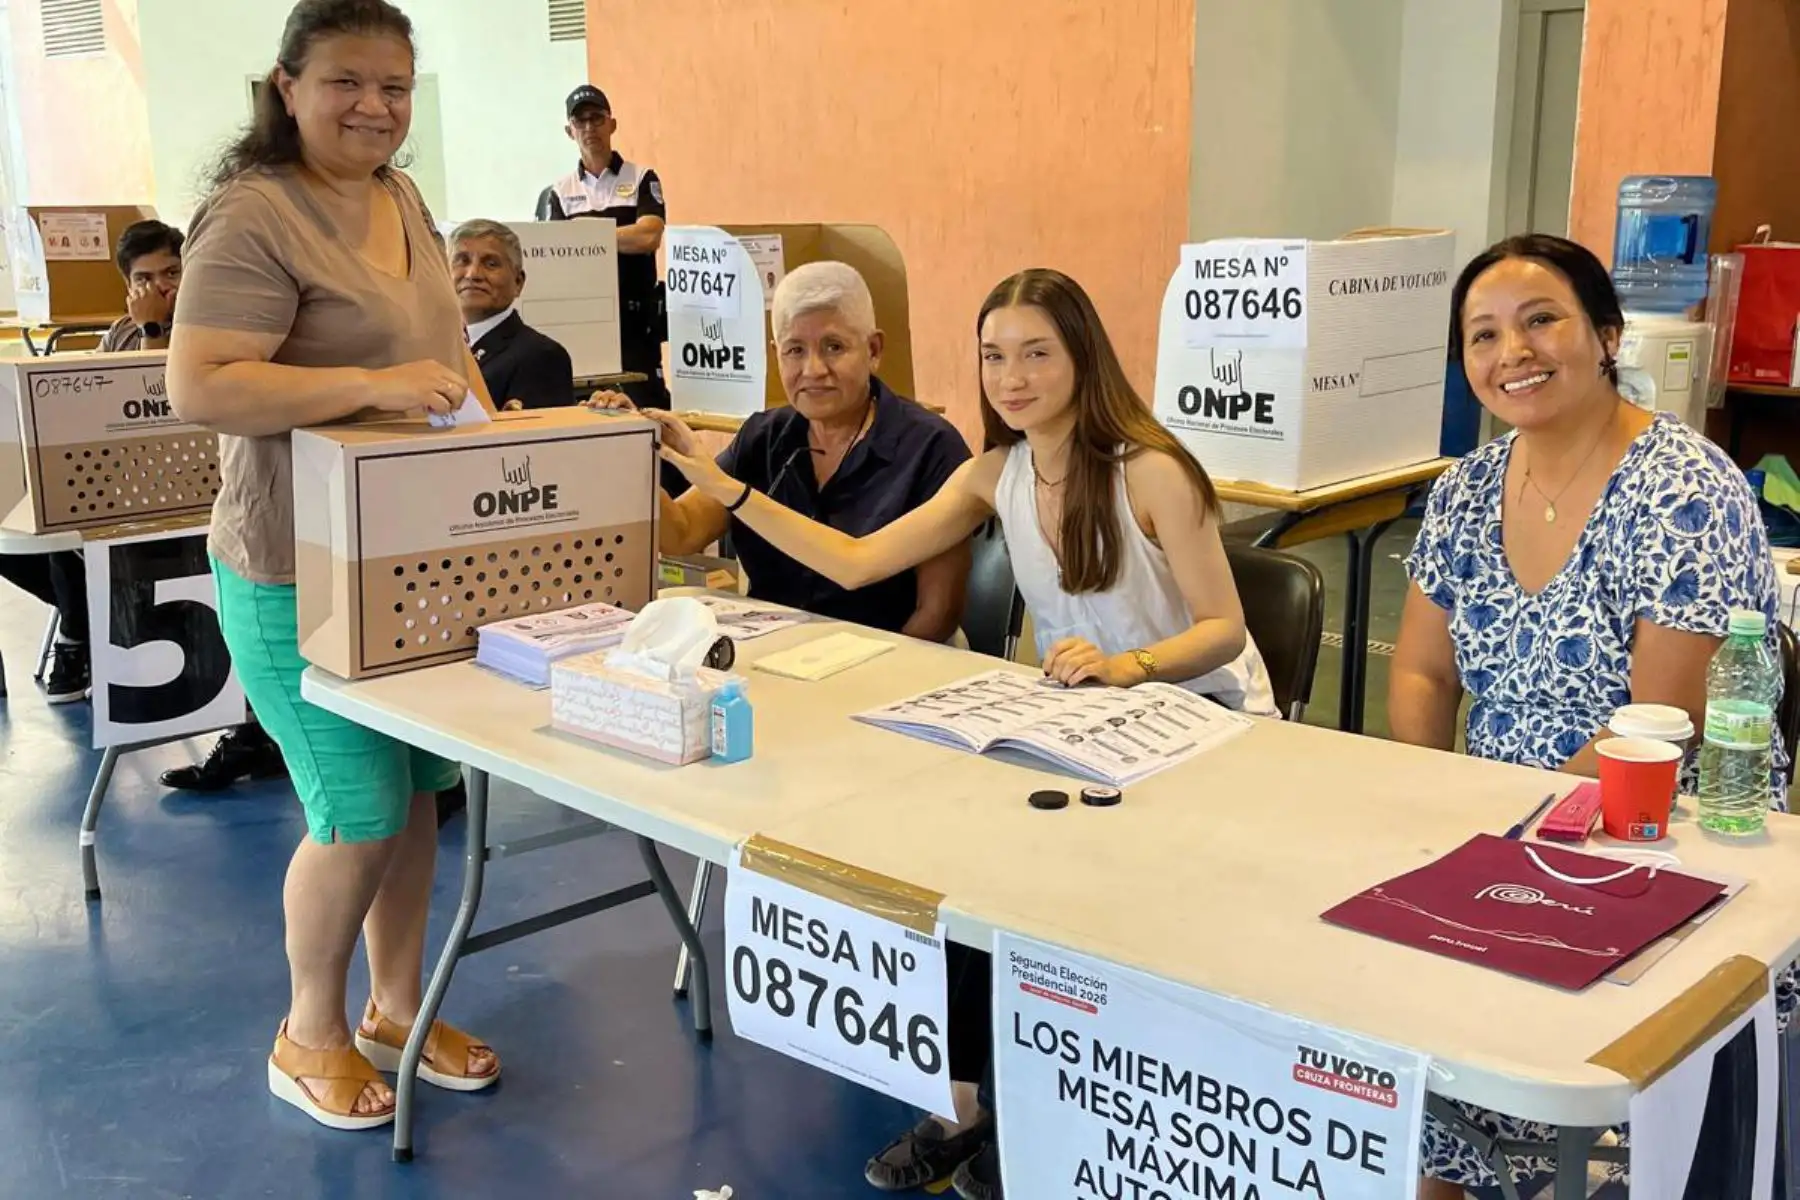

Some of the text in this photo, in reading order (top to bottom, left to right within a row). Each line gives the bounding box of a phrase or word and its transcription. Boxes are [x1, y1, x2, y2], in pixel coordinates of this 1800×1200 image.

[531, 246, 547, 258] DE
[549, 243, 608, 258] VOTACIÓN
[672, 245, 710, 264] MESA
[1194, 256, 1258, 280] MESA
[667, 267, 736, 297] 087647
[1328, 266, 1448, 297] CABINA DE VOTACIÓN
[1184, 286, 1303, 321] 087646
[682, 341, 746, 371] ONPE
[35, 375, 114, 398] 087647
[1311, 374, 1346, 393] MESA
[1177, 384, 1276, 425] ONPE
[473, 483, 559, 518] ONPE
[108, 534, 232, 725] 5
[751, 895, 861, 973] MESA
[1010, 951, 1108, 993] Segunda Elección
[1011, 965, 1078, 997] Presidencial
[1079, 988, 1108, 1006] 2026
[732, 945, 942, 1075] 087646
[1297, 1044, 1397, 1091] TU VOTO
[1014, 1010, 1388, 1176] LOS MIEMBROS DE
[1296, 1068, 1394, 1104] CRUZA FRONTERAS
[1058, 1068, 1327, 1200] MESA SON LA
